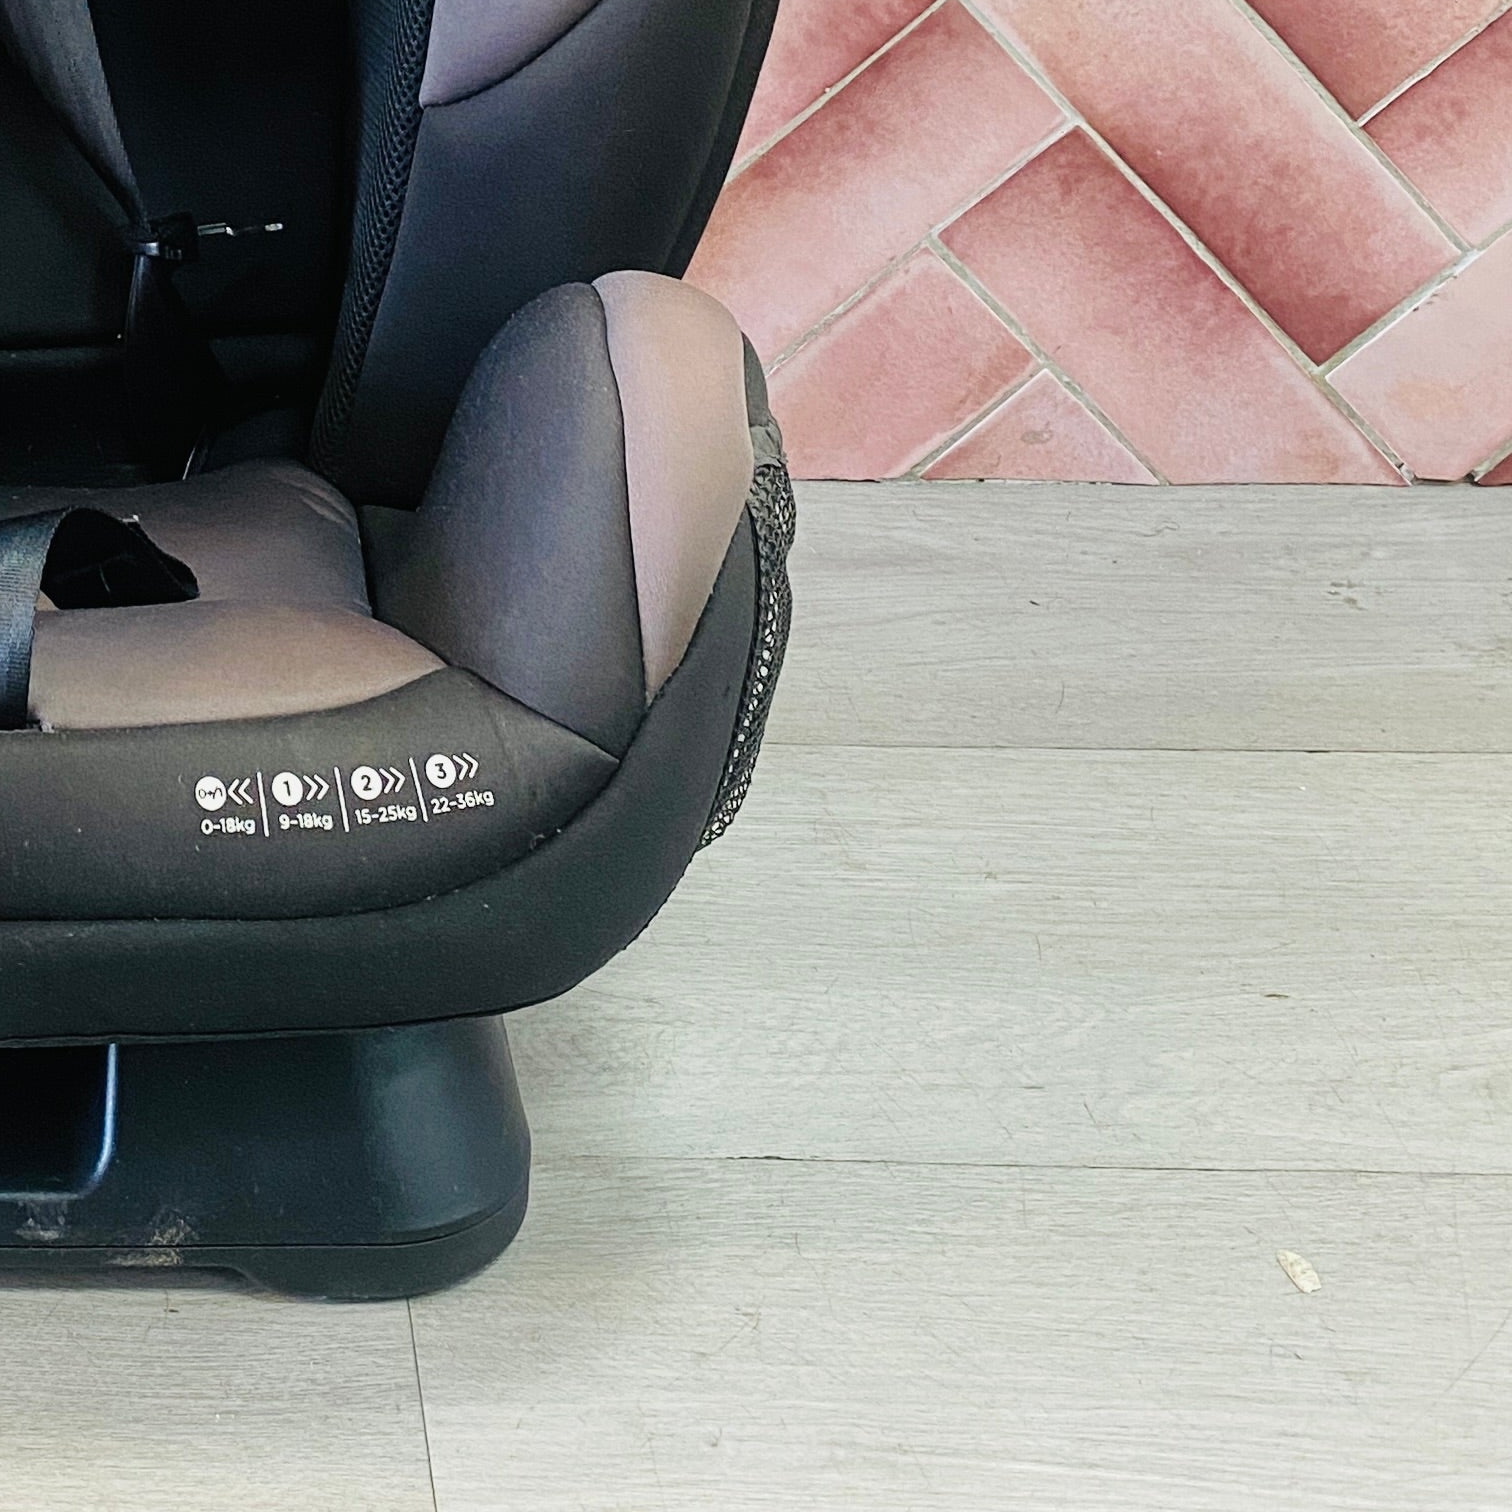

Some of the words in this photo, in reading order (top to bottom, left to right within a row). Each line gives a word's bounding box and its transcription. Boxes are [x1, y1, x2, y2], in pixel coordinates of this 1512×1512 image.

[283, 780, 292, 797] 1
[361, 775, 373, 792] 2
[434, 763, 448, 780] 3
[200, 817, 256, 836] 0-18kg
[278, 812, 333, 832] 9-18kg
[354, 804, 418, 825] 15-25kg
[430, 789, 495, 815] 22-36kg
